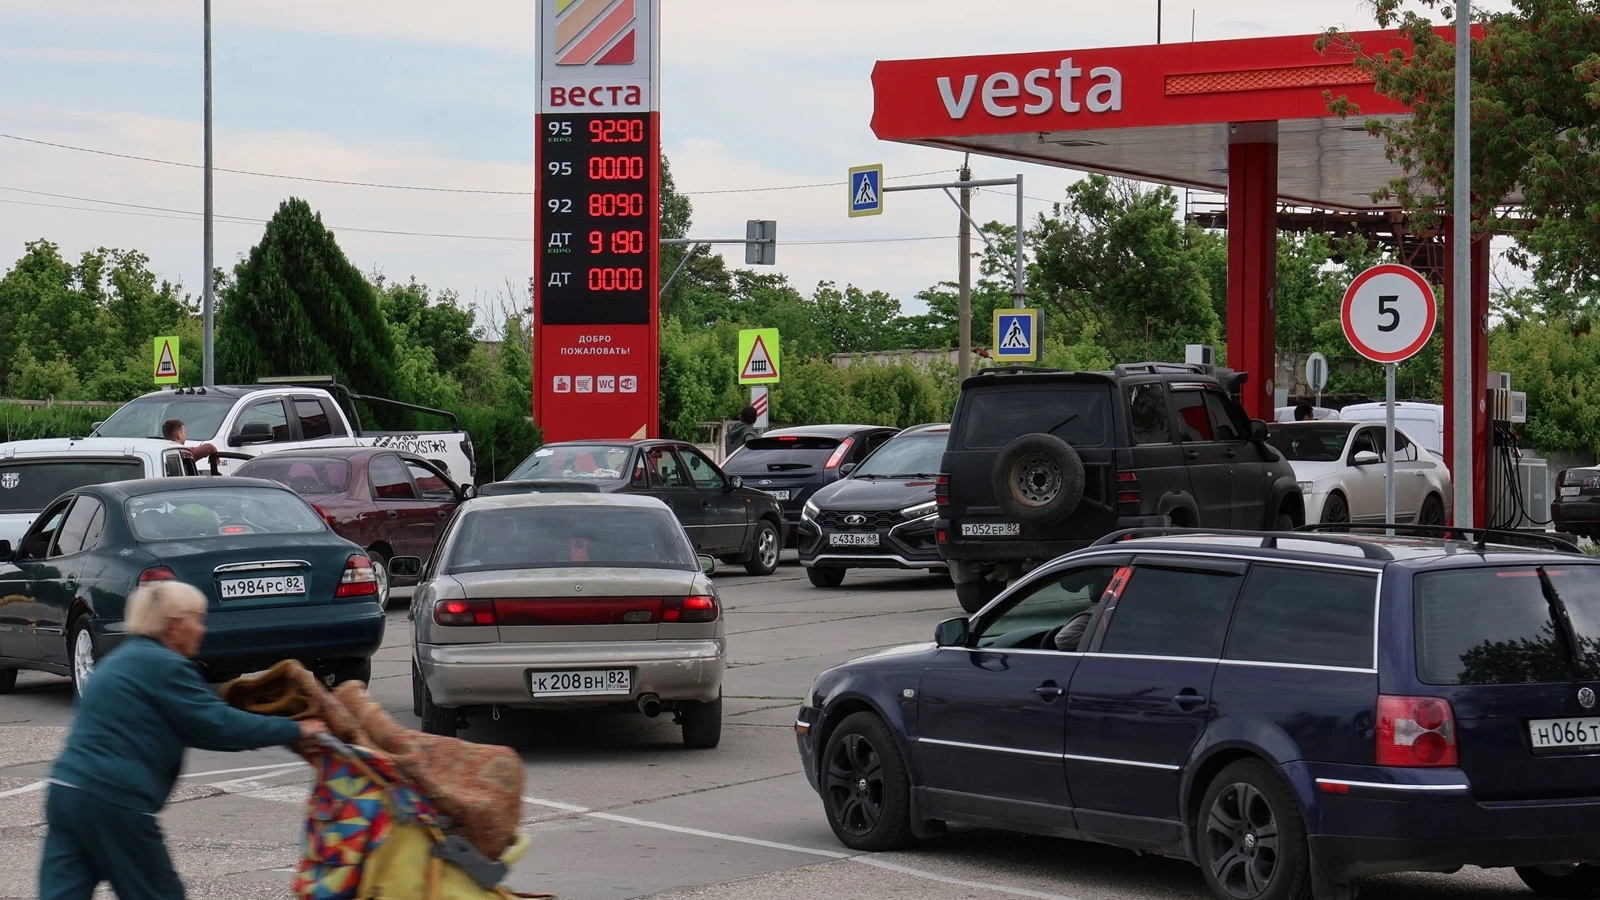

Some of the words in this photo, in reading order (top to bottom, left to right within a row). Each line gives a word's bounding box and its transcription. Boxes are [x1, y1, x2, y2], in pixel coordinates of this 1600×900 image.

[936, 57, 1122, 119] vesta
[548, 121, 572, 136] 95
[589, 119, 643, 142] 92.90
[548, 161, 572, 176] 95
[589, 156, 643, 179] 00.00
[548, 198, 572, 213] 92
[548, 232, 572, 248] ДТ
[548, 272, 572, 287] ДТ
[588, 267, 643, 291] 0000
[1267, 288, 1274, 310] 1
[1377, 295, 1400, 332] 5
[1481, 314, 1488, 335] 3
[578, 335, 612, 344] ДОБРО
[560, 347, 630, 355] ПОЖАЛОВАТЬ!
[598, 379, 614, 389] WC
[1006, 523, 1017, 532] 82
[867, 534, 877, 542] 68
[286, 577, 300, 588] 82
[608, 671, 624, 684] 82
